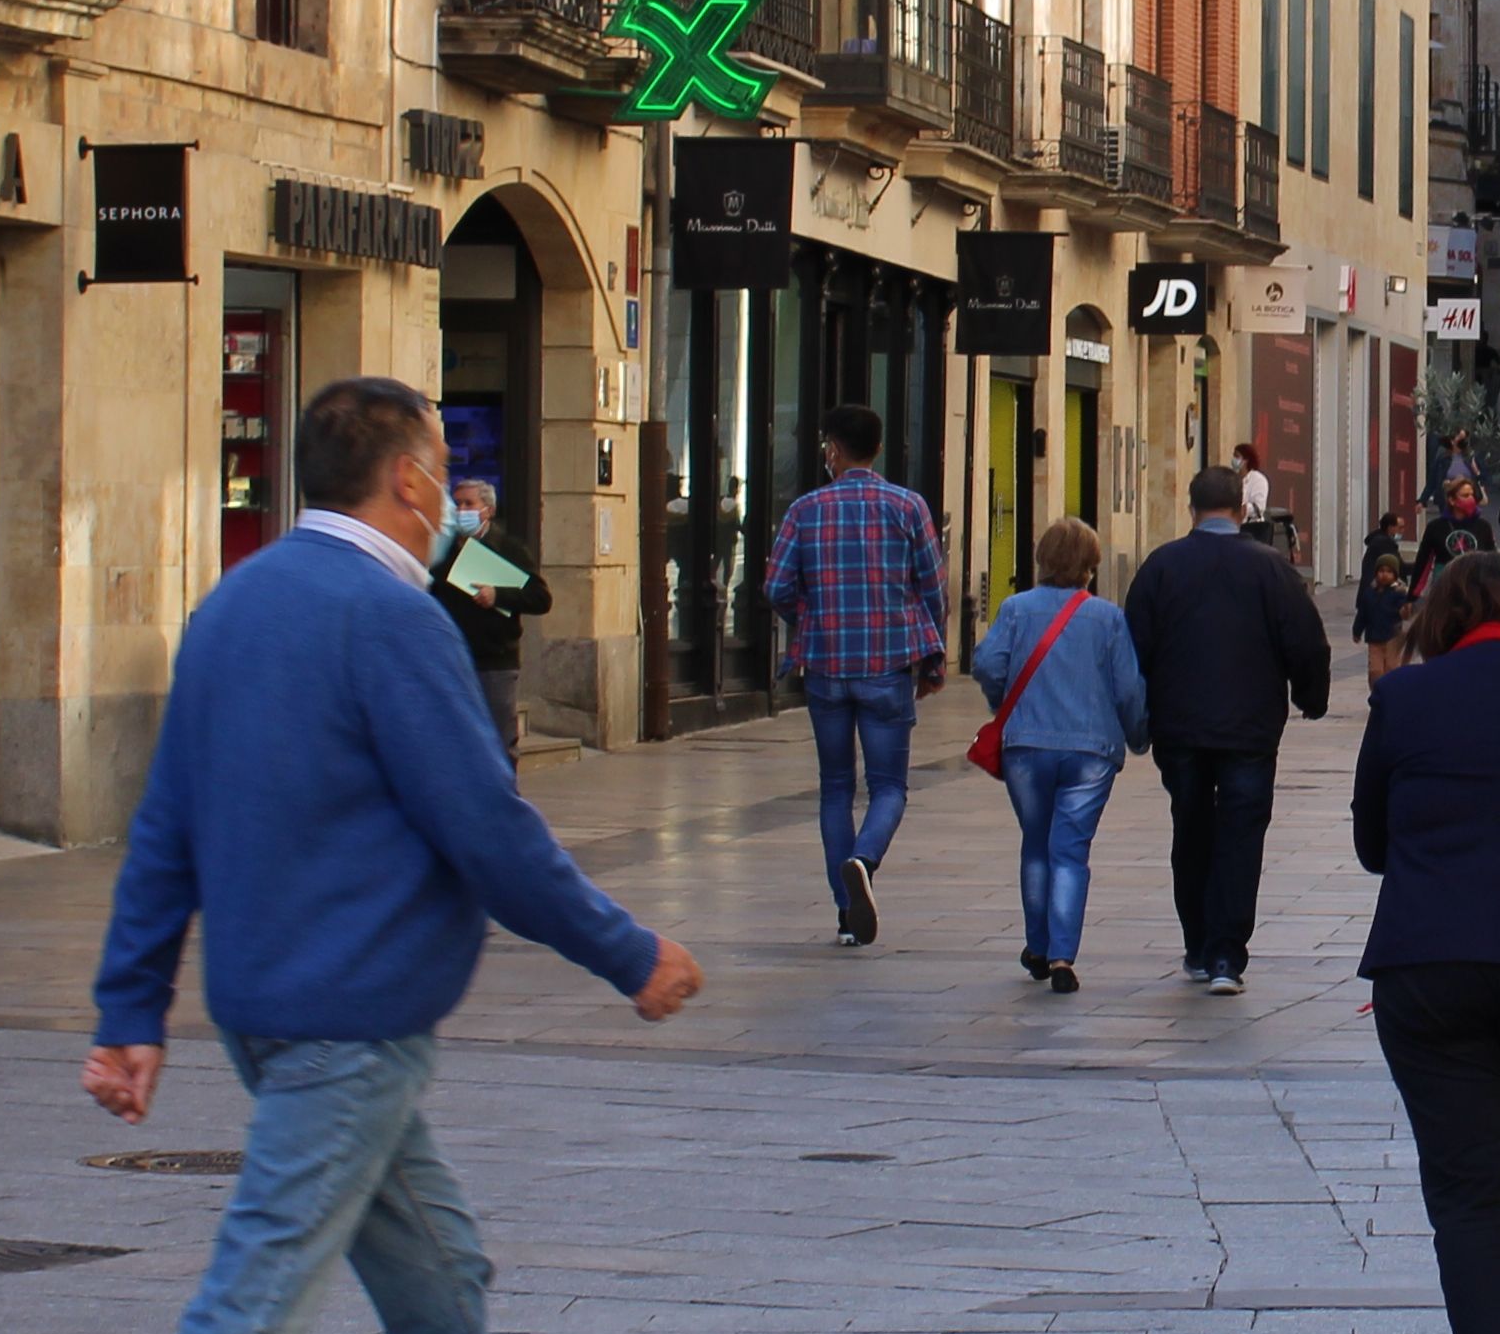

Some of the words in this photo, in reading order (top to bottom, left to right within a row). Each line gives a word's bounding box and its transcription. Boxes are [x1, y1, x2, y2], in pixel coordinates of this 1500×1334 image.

[98, 205, 182, 221] SEPHORA
[277, 179, 443, 270] PARAFARMACIA
[1143, 279, 1198, 318] JD
[1441, 307, 1477, 332] H&M
